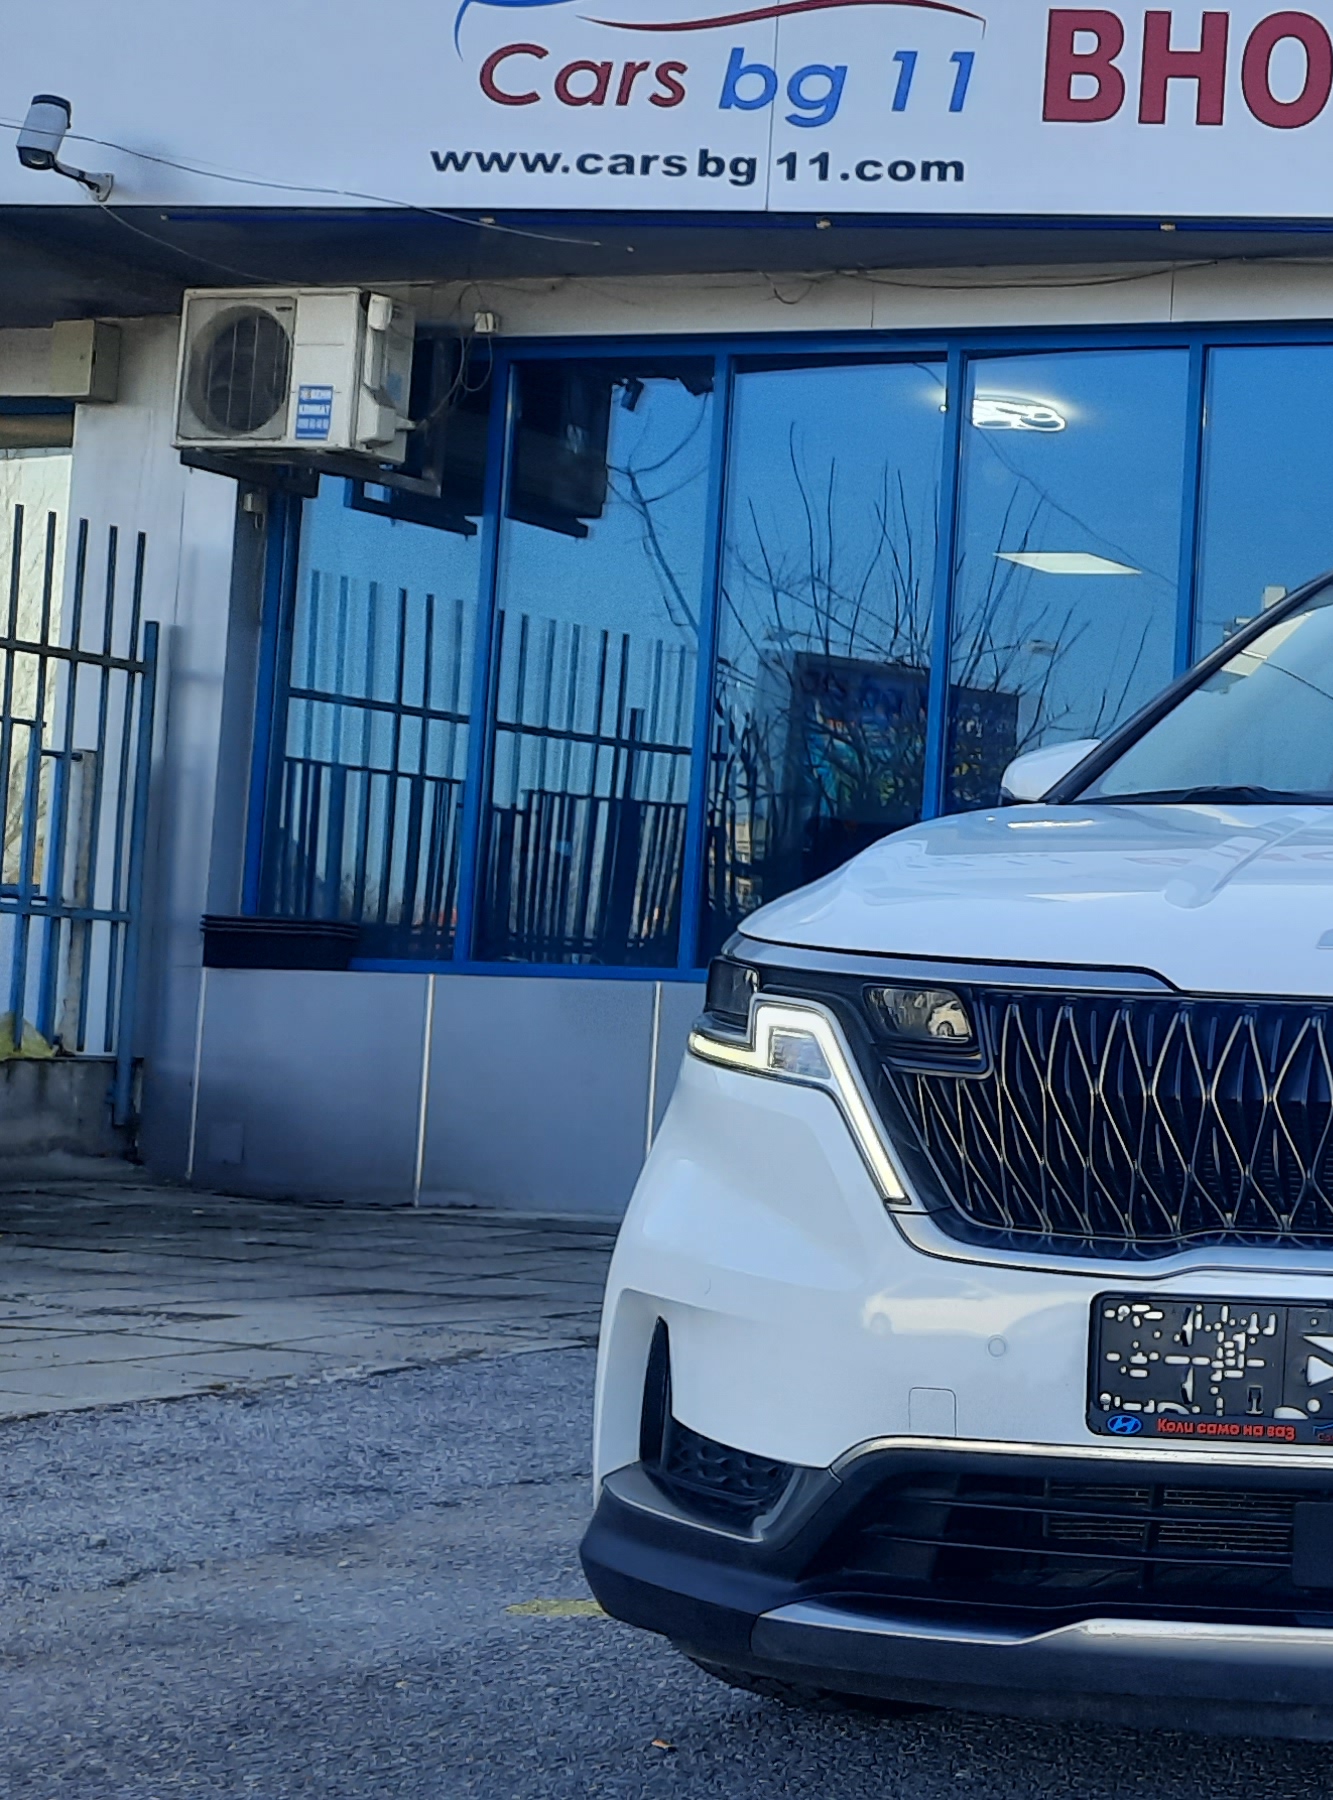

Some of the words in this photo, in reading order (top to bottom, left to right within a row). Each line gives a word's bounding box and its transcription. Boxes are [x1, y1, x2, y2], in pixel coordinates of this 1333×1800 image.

[480, 42, 689, 109] Cars
[718, 47, 848, 128] bg
[890, 50, 976, 113] 11
[1157, 1418, 1194, 1434] Коли
[1196, 1422, 1240, 1436] само
[1243, 1424, 1264, 1437] на
